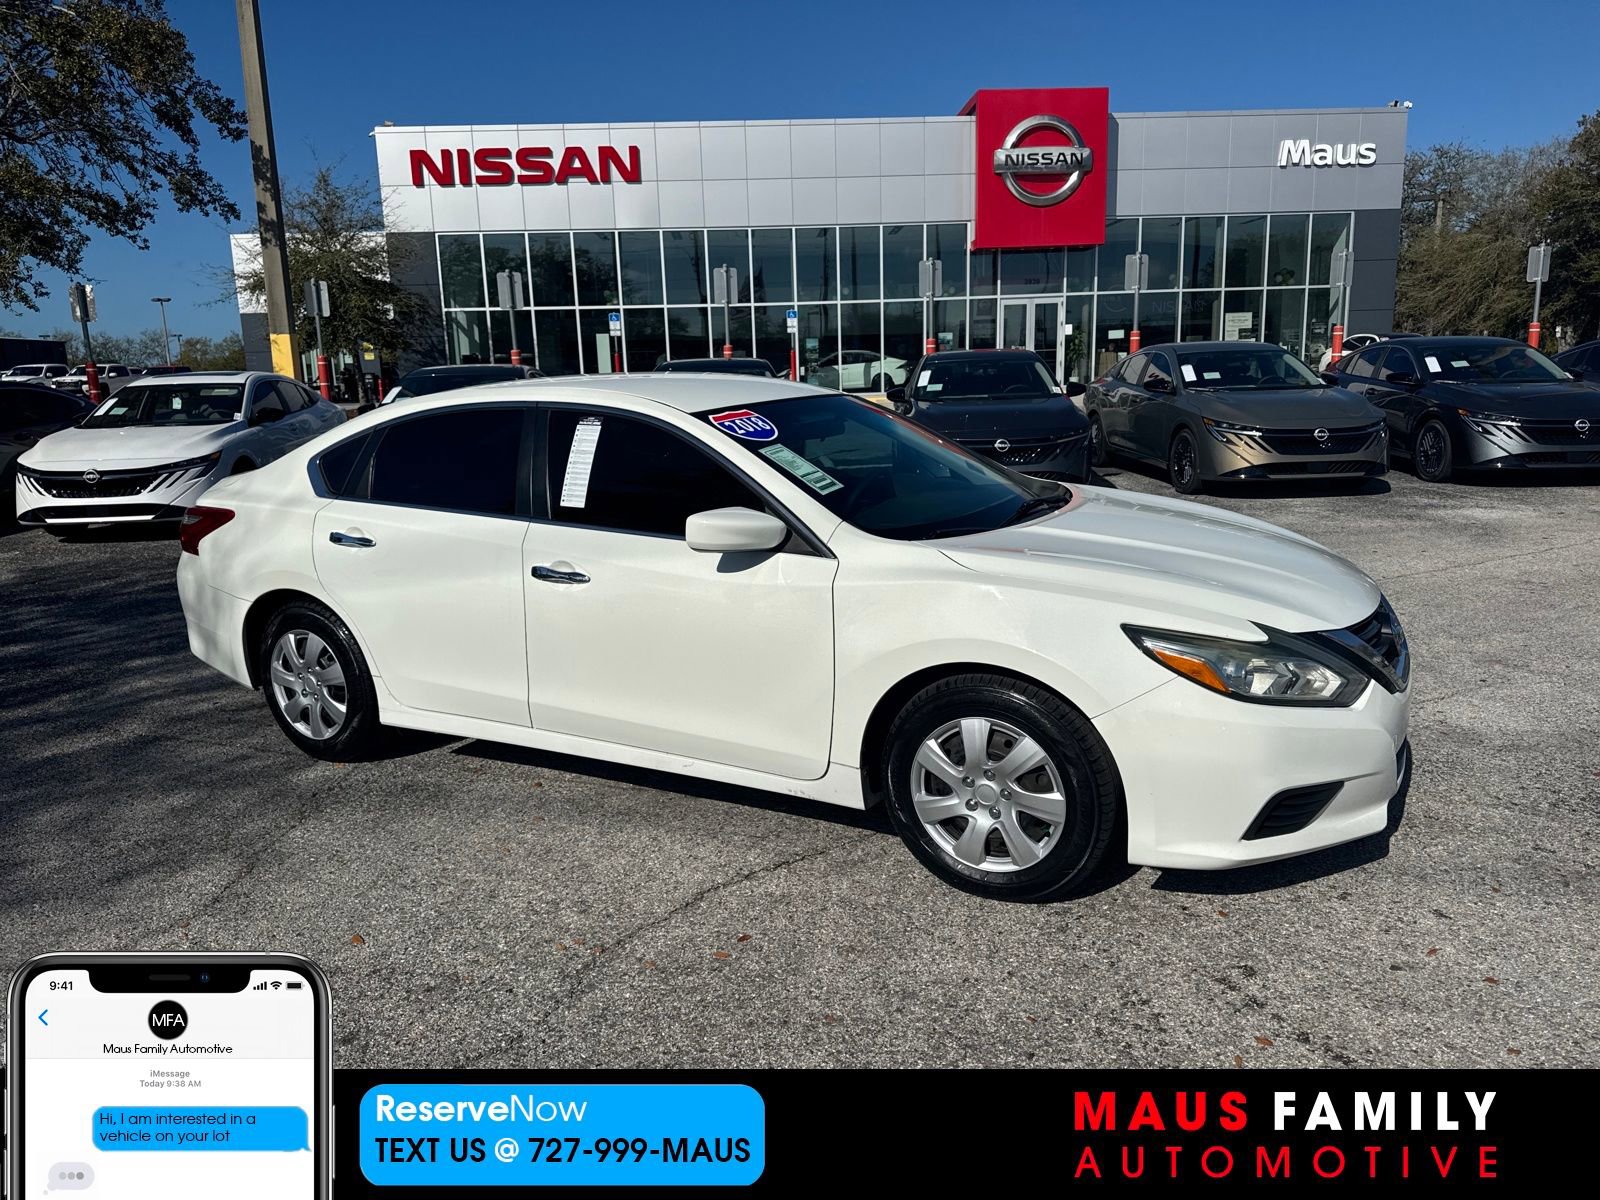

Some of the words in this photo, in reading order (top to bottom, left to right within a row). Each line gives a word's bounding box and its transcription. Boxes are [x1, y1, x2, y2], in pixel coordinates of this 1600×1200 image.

[1003, 151, 1085, 169] NISSAN
[1278, 138, 1378, 167] Maus
[409, 146, 641, 187] NISSAN
[723, 416, 772, 435] 2018
